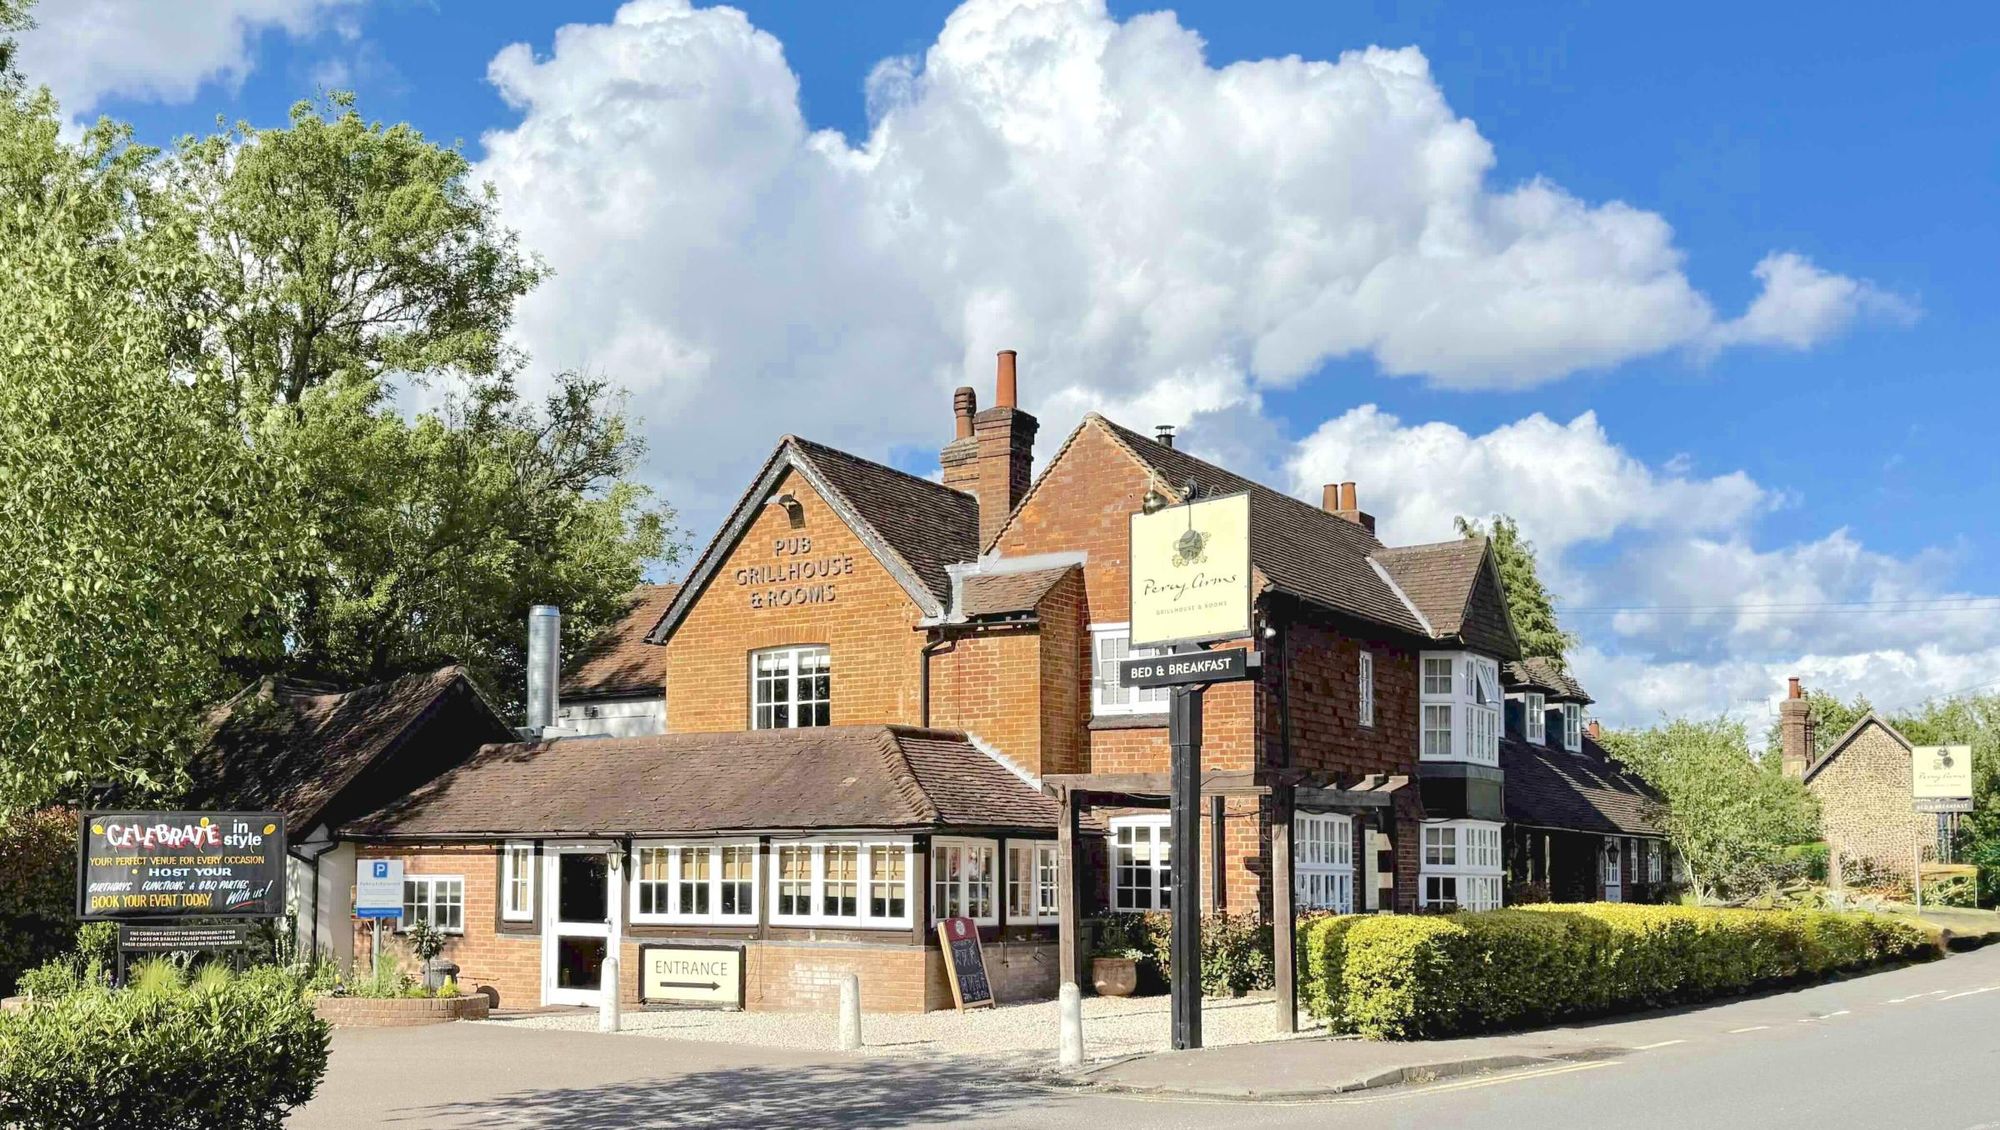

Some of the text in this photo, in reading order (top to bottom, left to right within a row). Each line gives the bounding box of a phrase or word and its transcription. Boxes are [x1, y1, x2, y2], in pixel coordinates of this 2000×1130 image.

[775, 537, 811, 556] PUB
[736, 556, 853, 586] GRILLHOUSE
[1143, 572, 1237, 602] Percy Arms
[751, 584, 836, 609] & ROOMS
[1156, 604, 1195, 616] GRILLHOUSE
[1204, 600, 1228, 610] ROOMS
[1130, 657, 1232, 679] BED & BREAKFAST
[232, 818, 249, 834] in
[106, 823, 221, 849] CELEBRATE
[223, 831, 262, 849] style
[89, 855, 265, 867] YOUR PERFECT VENUE FOR EVERY OCCASION
[148, 867, 232, 877] HOST YOUR
[376, 863, 386, 877] P
[88, 881, 133, 893] BIRTHDAYS
[141, 880, 186, 892] FUNCTIONS
[198, 880, 217, 890] BBQ
[218, 879, 250, 890] PARTIES
[91, 892, 213, 909] BOOK YOUR EVENT TODAY
[225, 887, 251, 906] With
[655, 960, 728, 977] ENTRANCE
